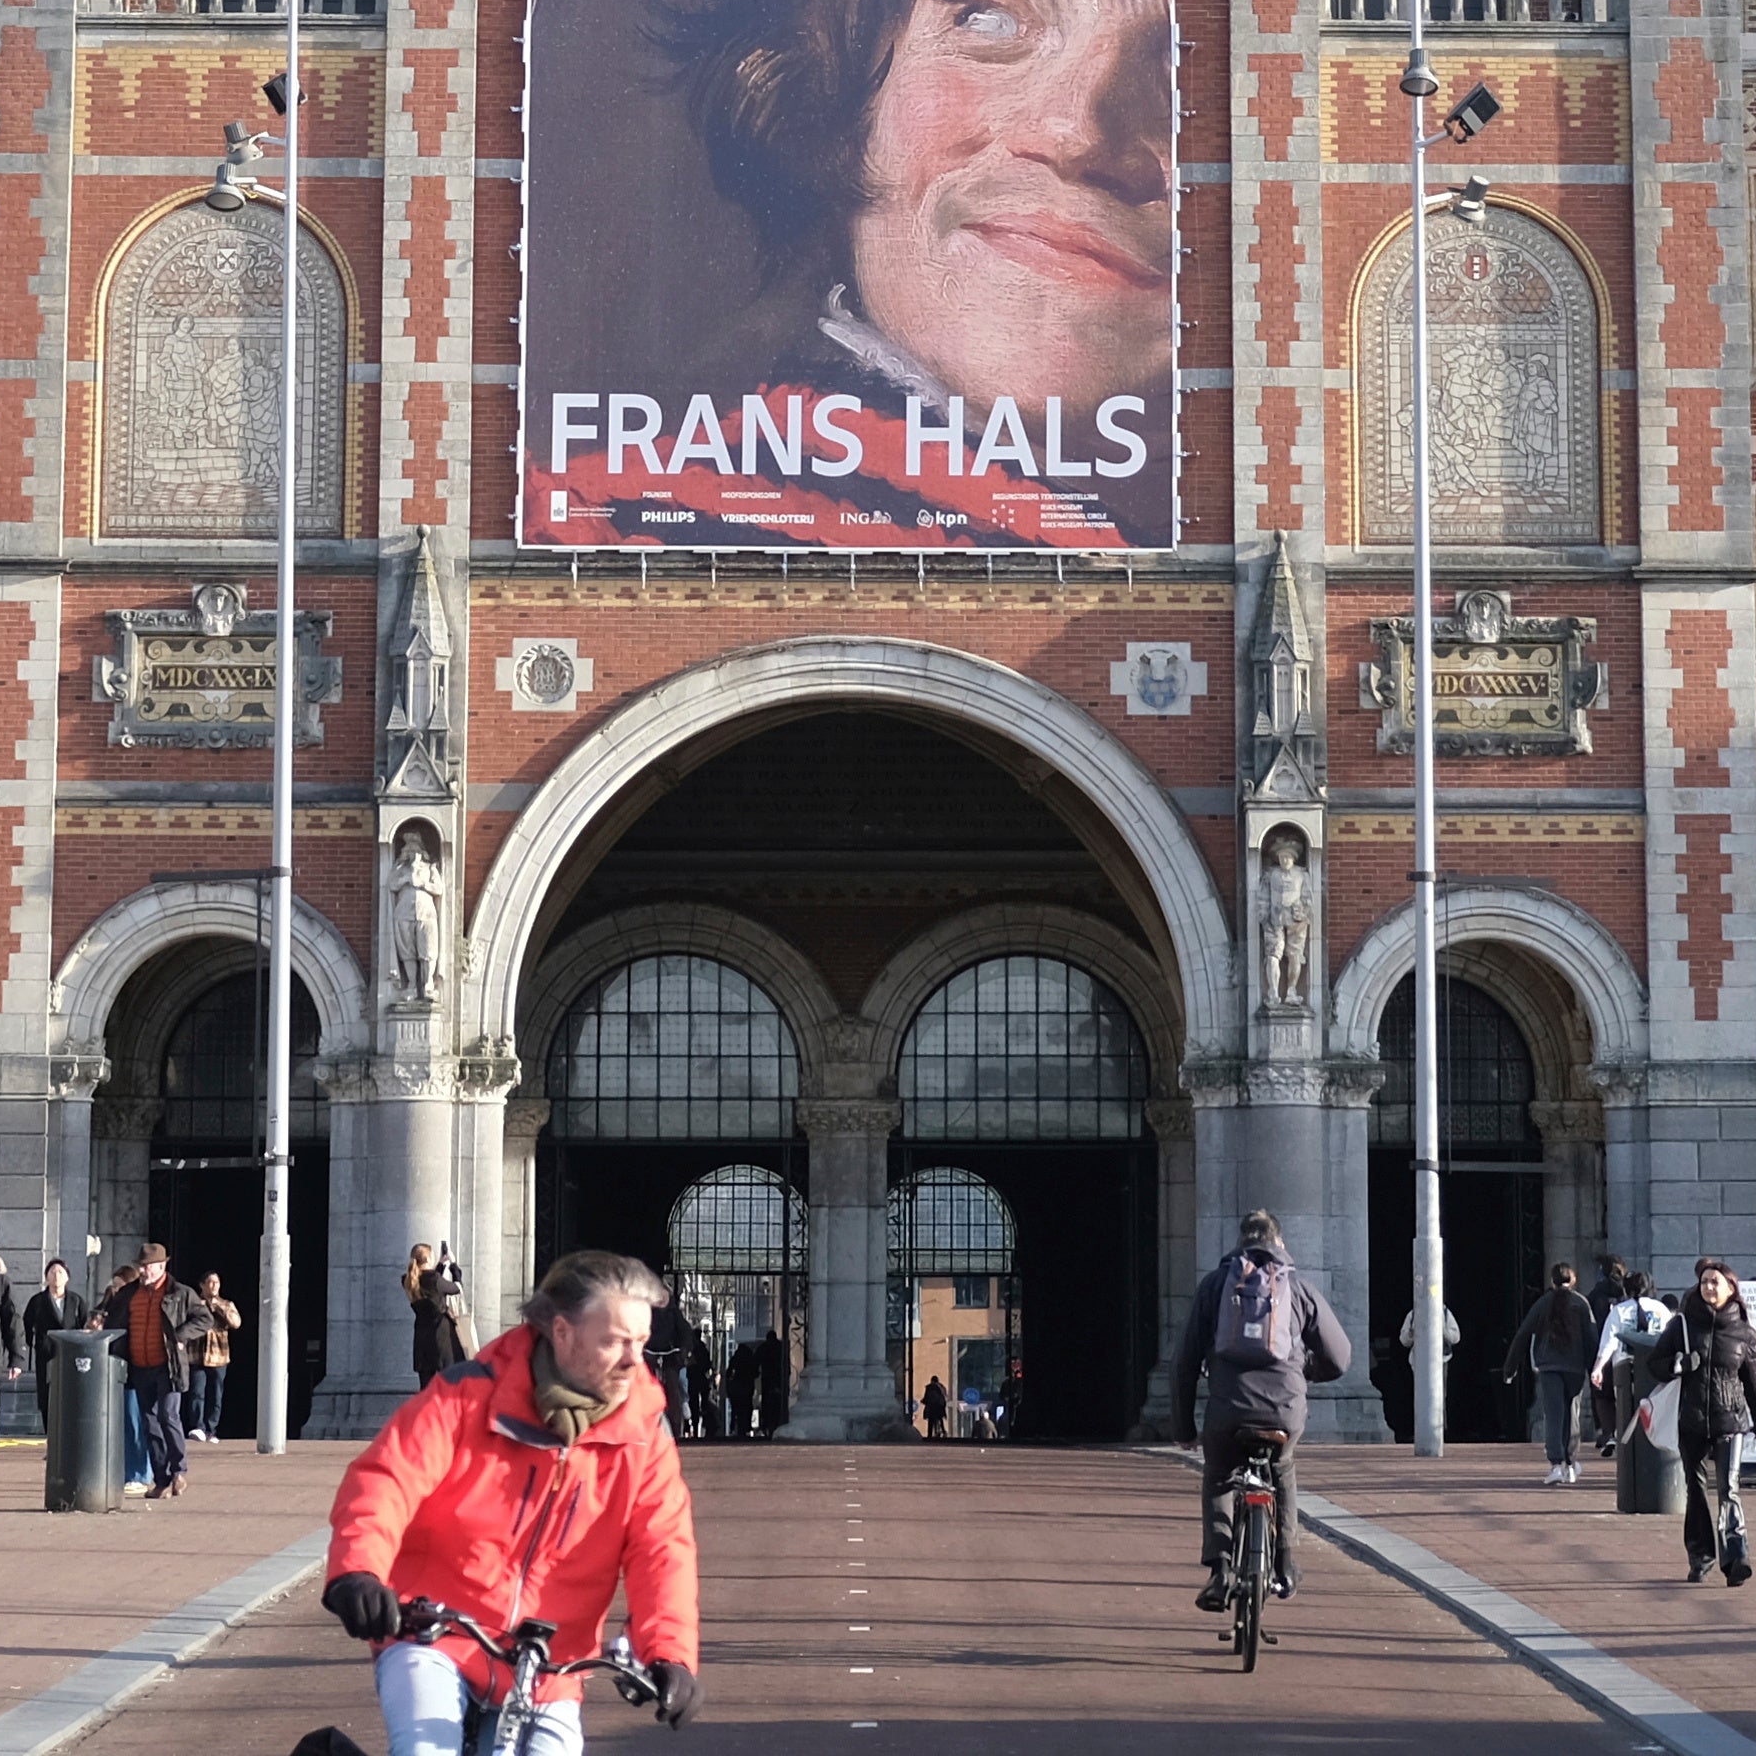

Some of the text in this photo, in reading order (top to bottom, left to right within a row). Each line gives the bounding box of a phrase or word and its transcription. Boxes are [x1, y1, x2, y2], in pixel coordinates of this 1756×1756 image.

[551, 392, 1147, 478] FRANS HALS
[641, 511, 696, 523] PHILIPS
[721, 513, 815, 524] VRIENDENLOTERIJ
[839, 512, 869, 525] ING
[936, 510, 968, 527] kpn
